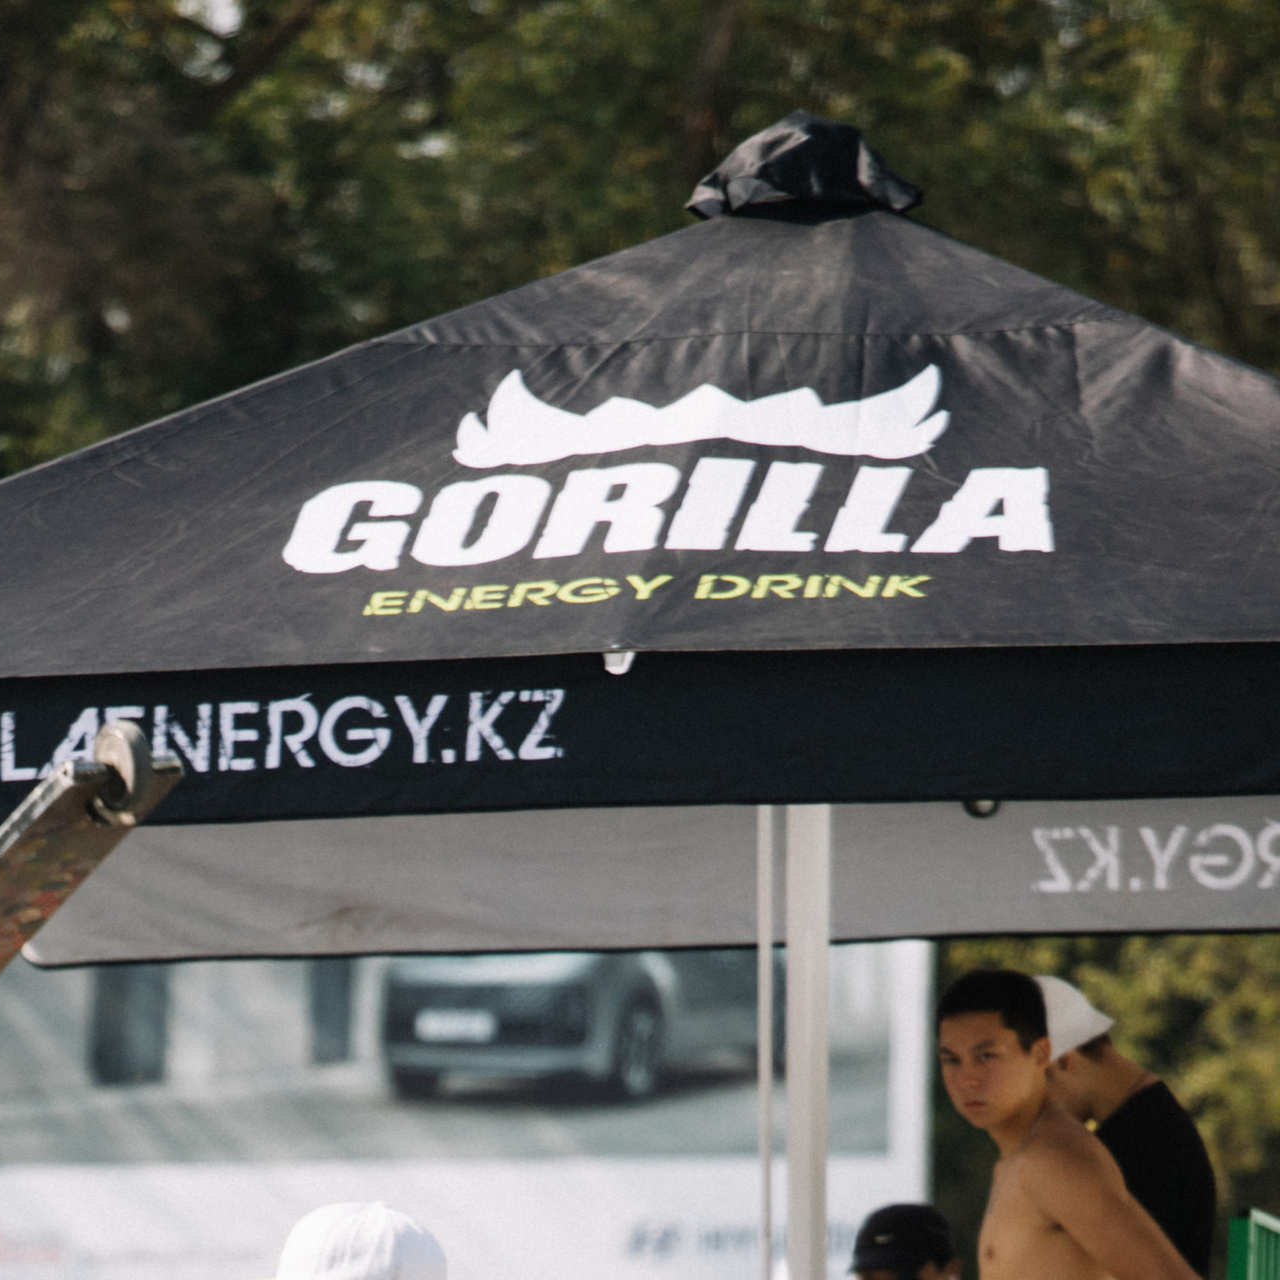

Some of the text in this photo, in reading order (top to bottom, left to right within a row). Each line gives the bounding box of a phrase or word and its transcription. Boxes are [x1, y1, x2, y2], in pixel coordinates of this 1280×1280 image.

[282, 457, 1056, 574] GORILLA
[362, 572, 934, 617] ENERGY DRINK
